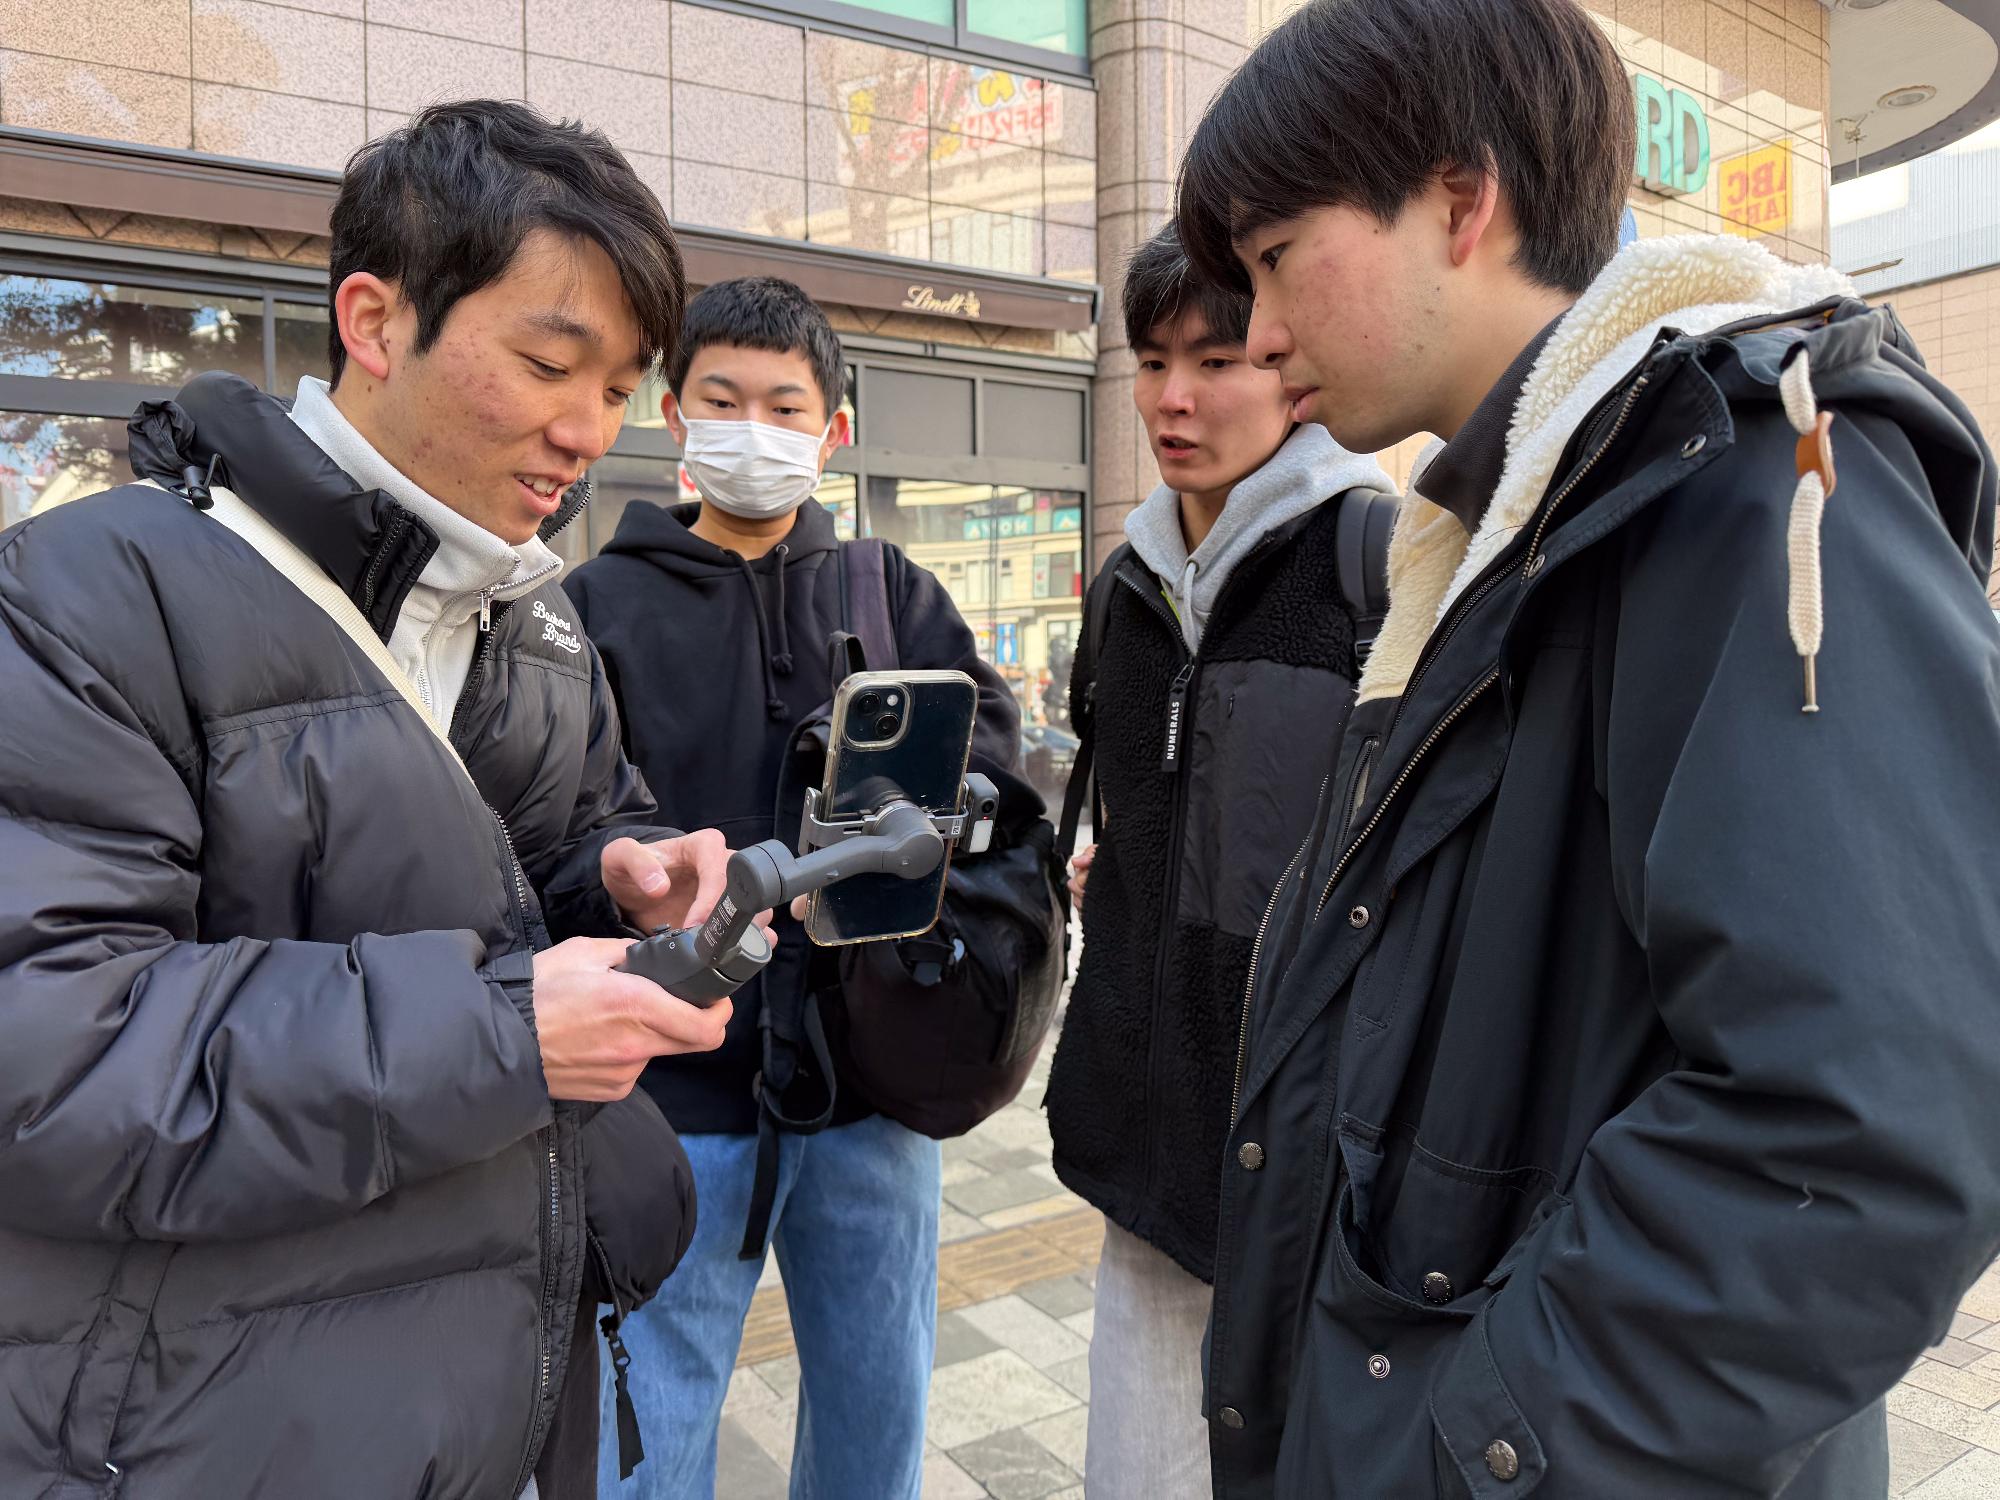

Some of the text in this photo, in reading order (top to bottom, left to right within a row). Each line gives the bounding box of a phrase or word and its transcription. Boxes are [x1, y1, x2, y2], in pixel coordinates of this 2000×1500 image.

[1636, 73, 1710, 193] RD
[902, 285, 964, 314] Lindt
[542, 622, 581, 653] Brand
[1166, 701, 1179, 759] NUMERALS
